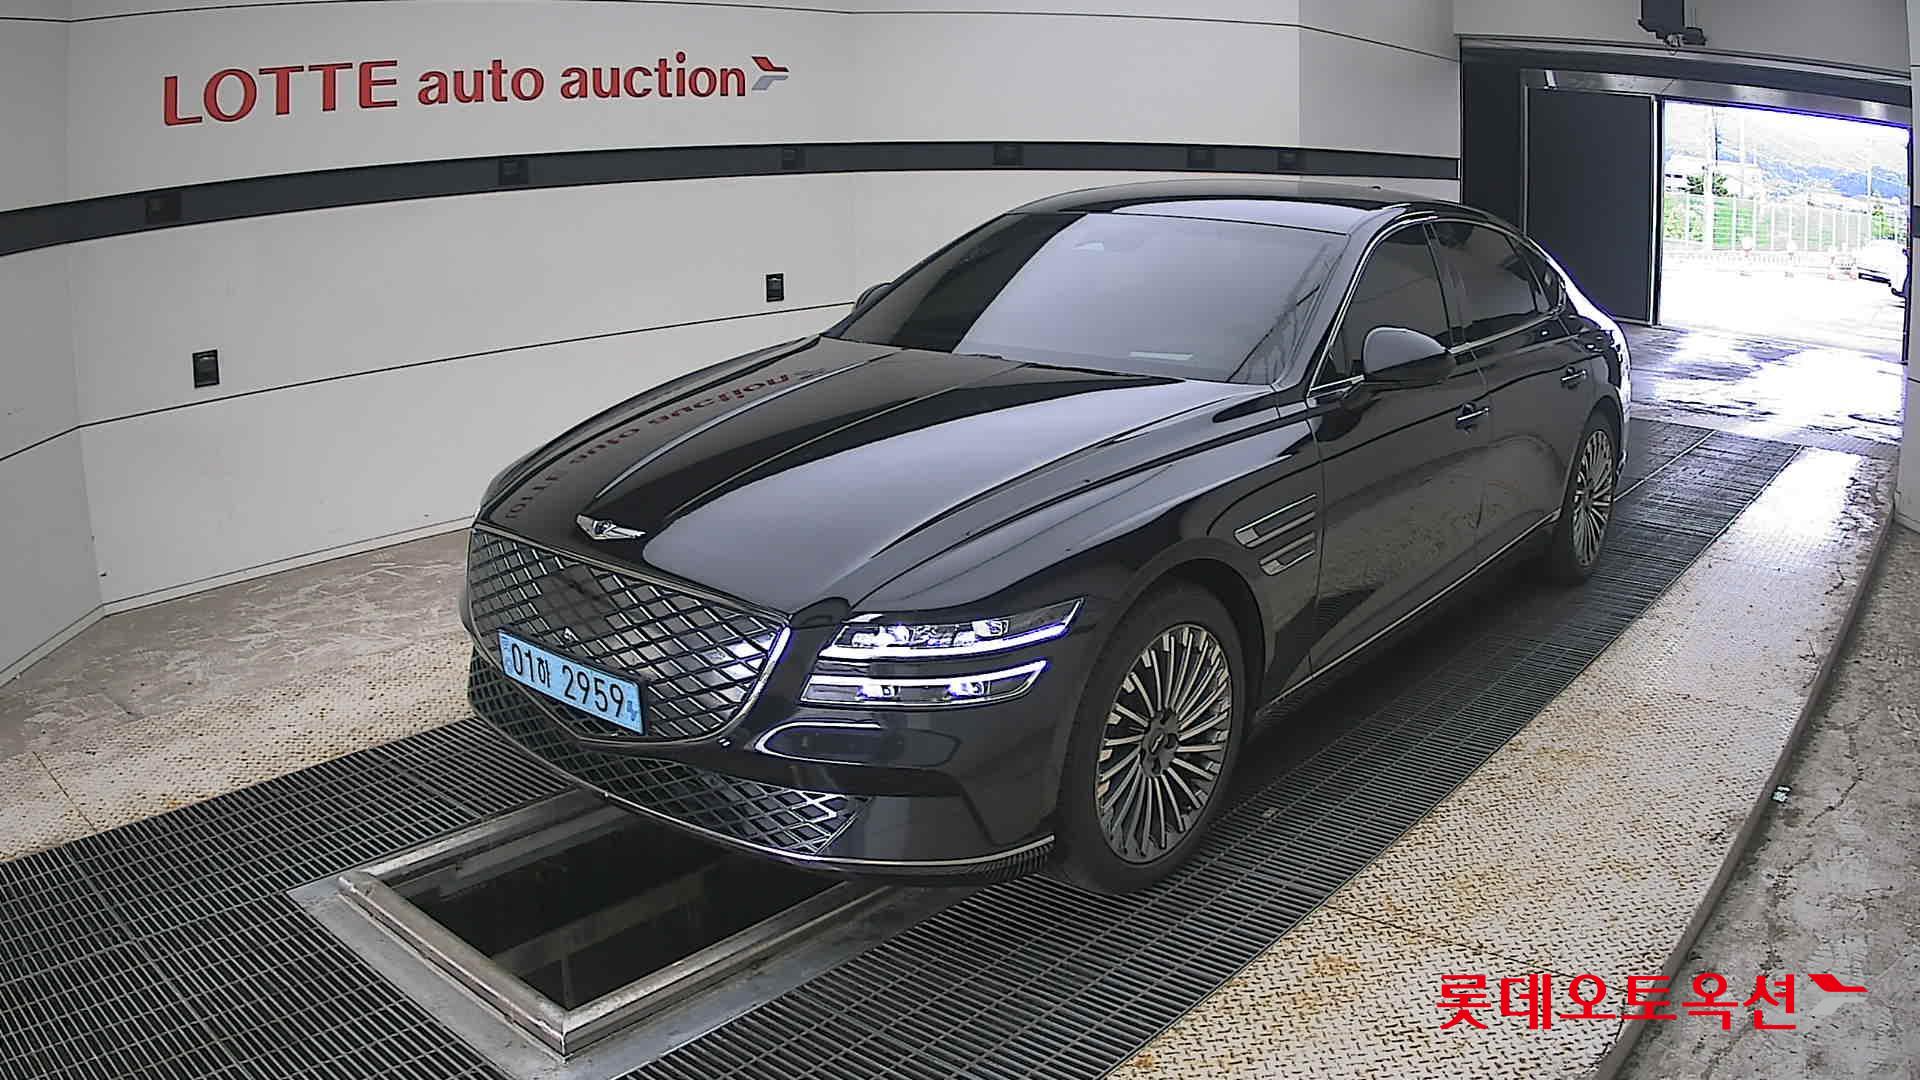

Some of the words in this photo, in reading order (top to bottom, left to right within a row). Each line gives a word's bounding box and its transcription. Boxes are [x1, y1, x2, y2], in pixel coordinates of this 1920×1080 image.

[163, 60, 398, 126] LOTTE
[417, 59, 545, 105] auto
[560, 51, 747, 99] auction
[561, 664, 624, 718] 2959
